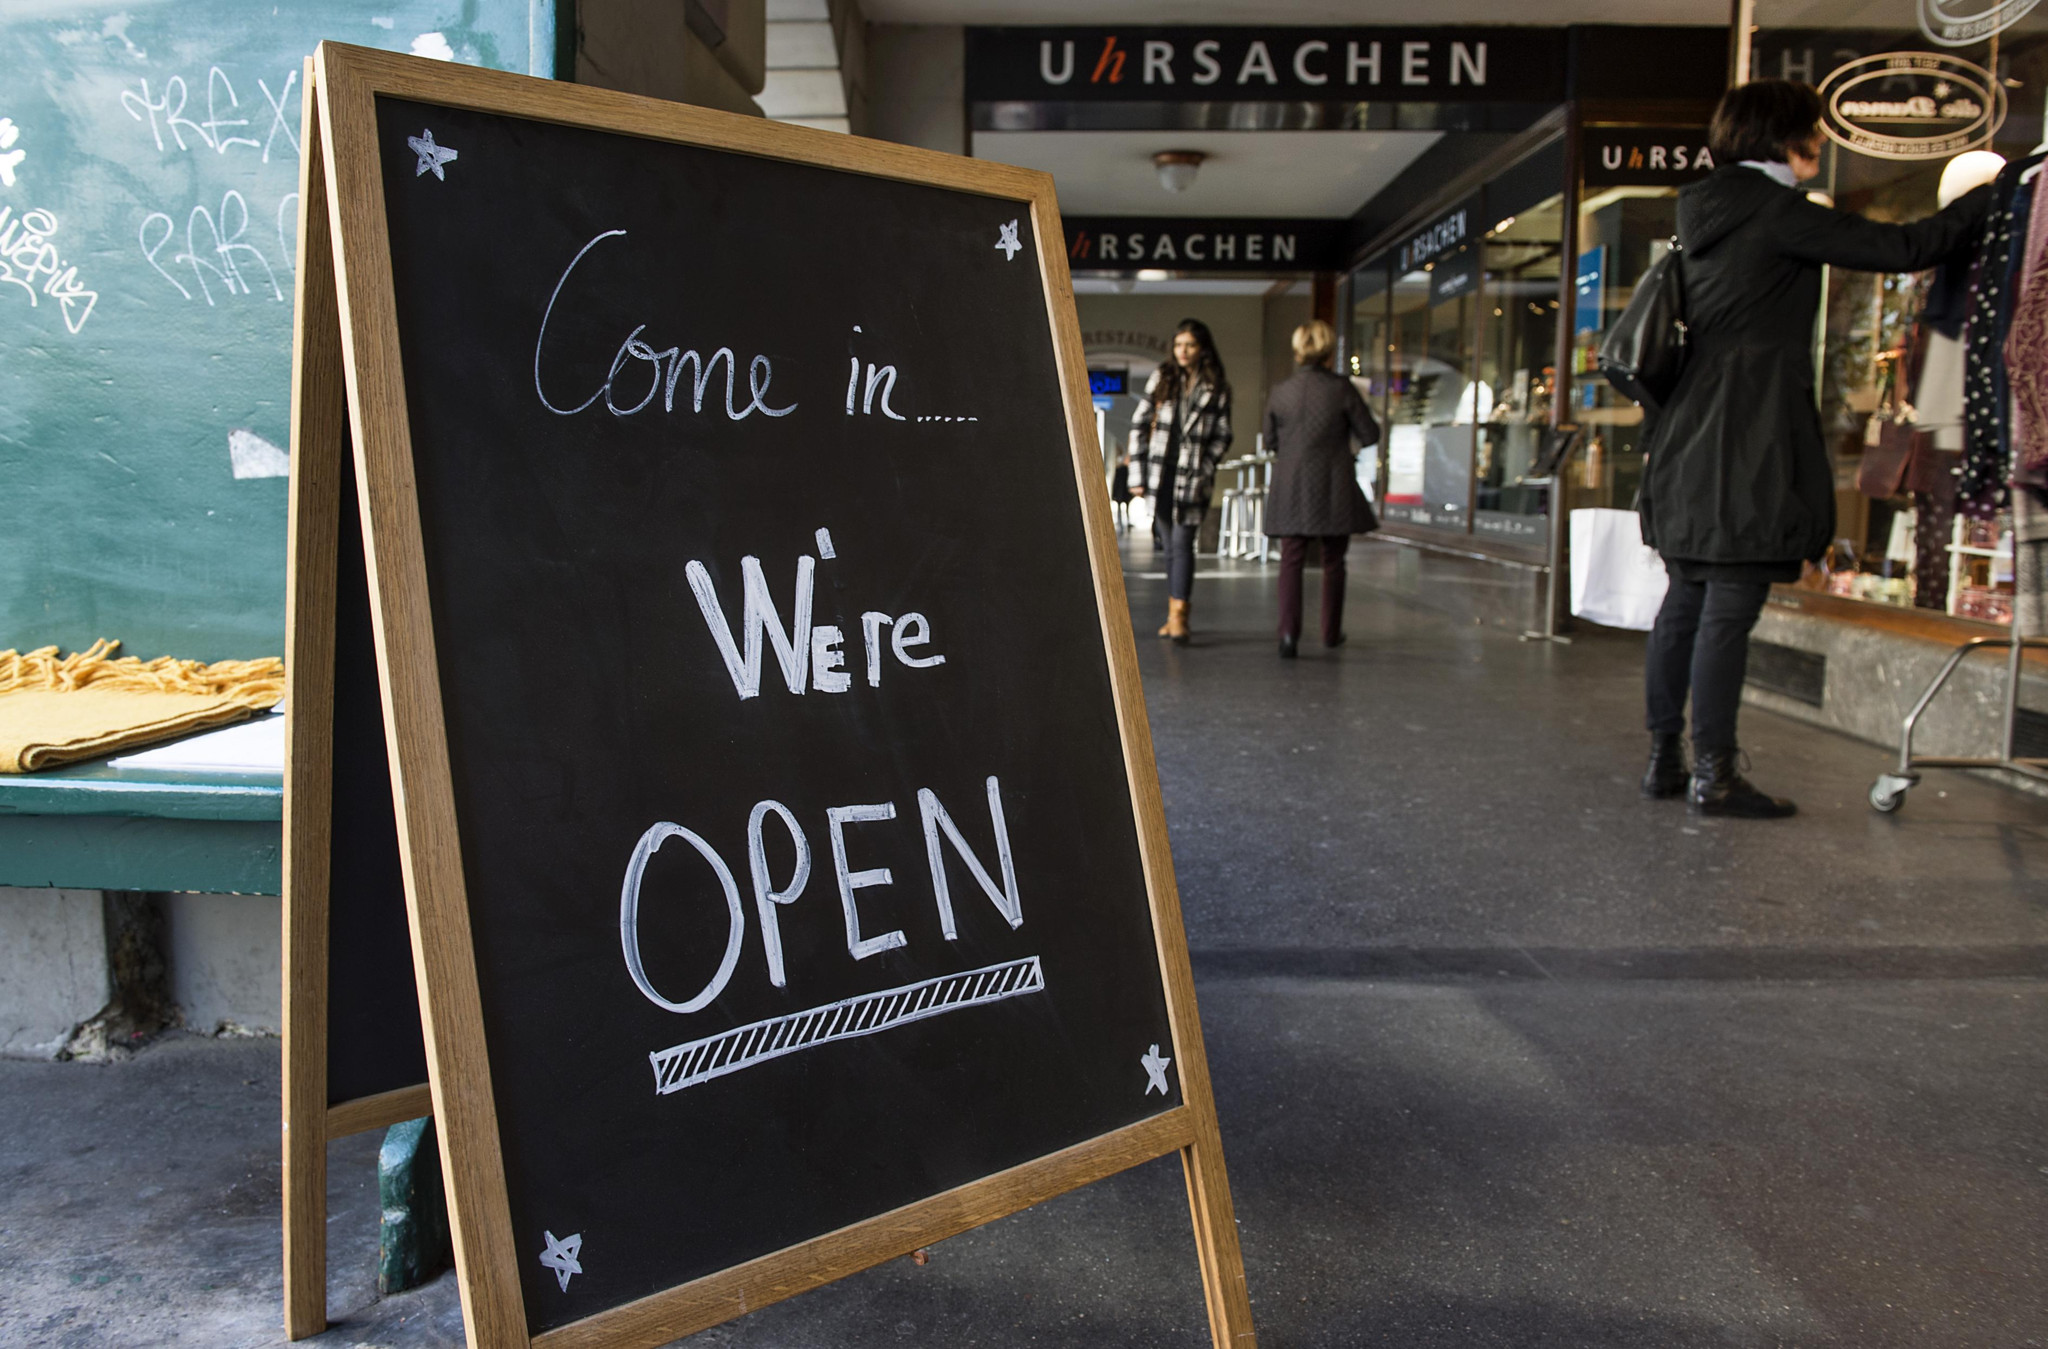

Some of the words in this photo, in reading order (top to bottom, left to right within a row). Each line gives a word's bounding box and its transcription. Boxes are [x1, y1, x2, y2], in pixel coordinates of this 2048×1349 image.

[1039, 36, 1488, 86] UhRSACHEN
[535, 229, 799, 421] Come
[620, 775, 1025, 1014] OPEN
